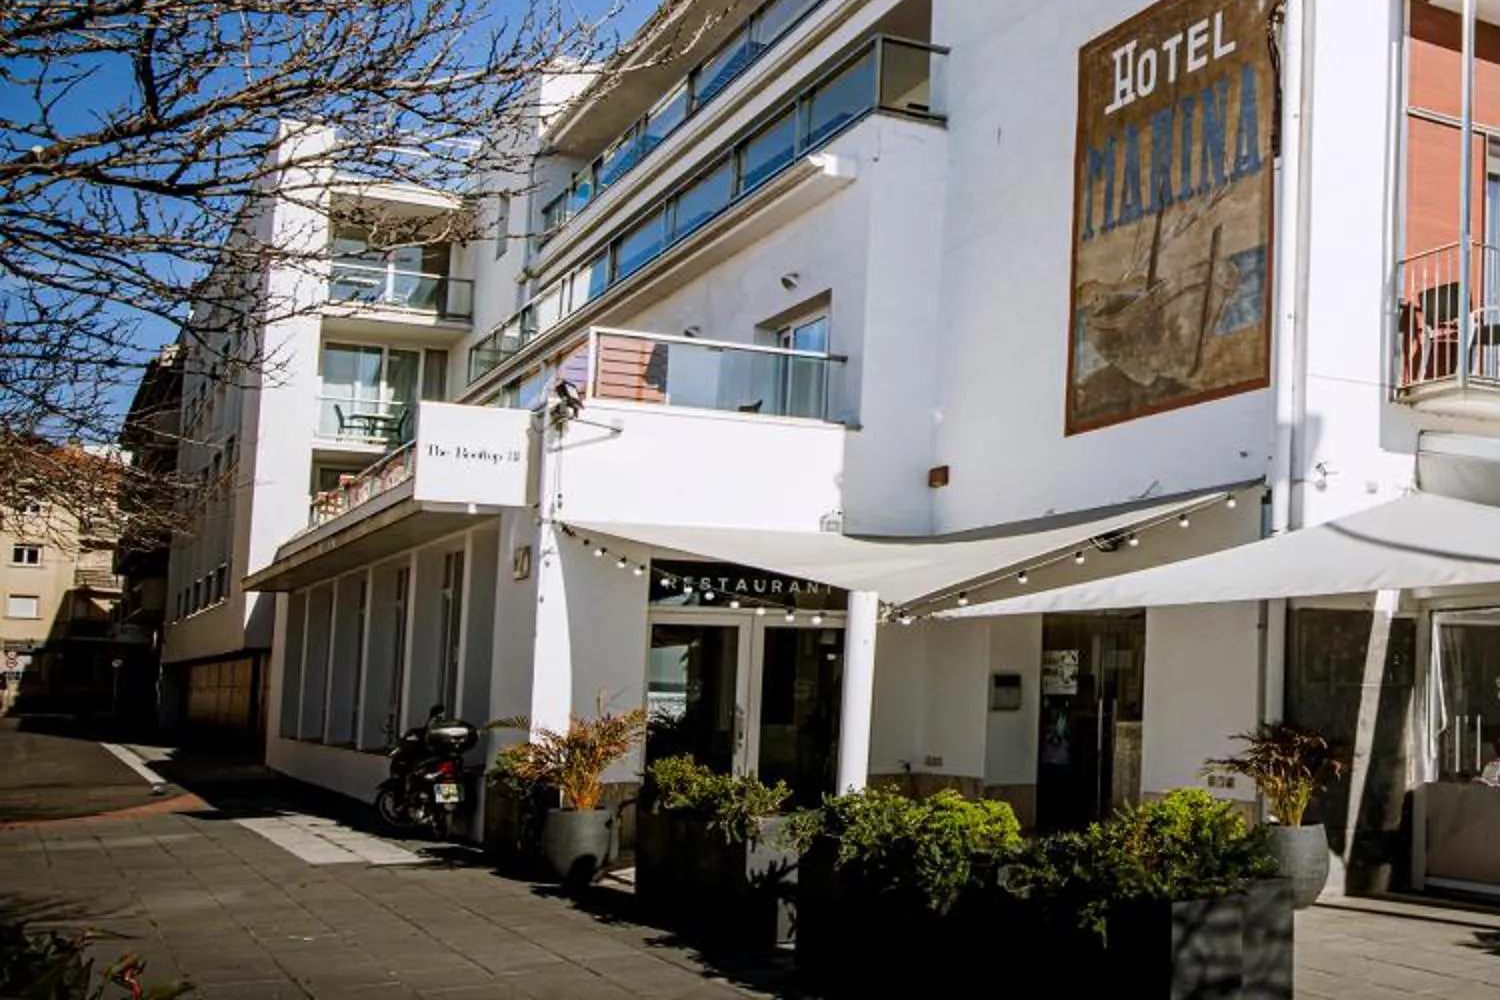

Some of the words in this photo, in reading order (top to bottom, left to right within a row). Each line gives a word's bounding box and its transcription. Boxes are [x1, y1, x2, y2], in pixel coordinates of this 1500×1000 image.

[1104, 10, 1237, 116] HOTEL
[1082, 60, 1264, 242] MARINA
[665, 573, 833, 593] RESTAURANT
